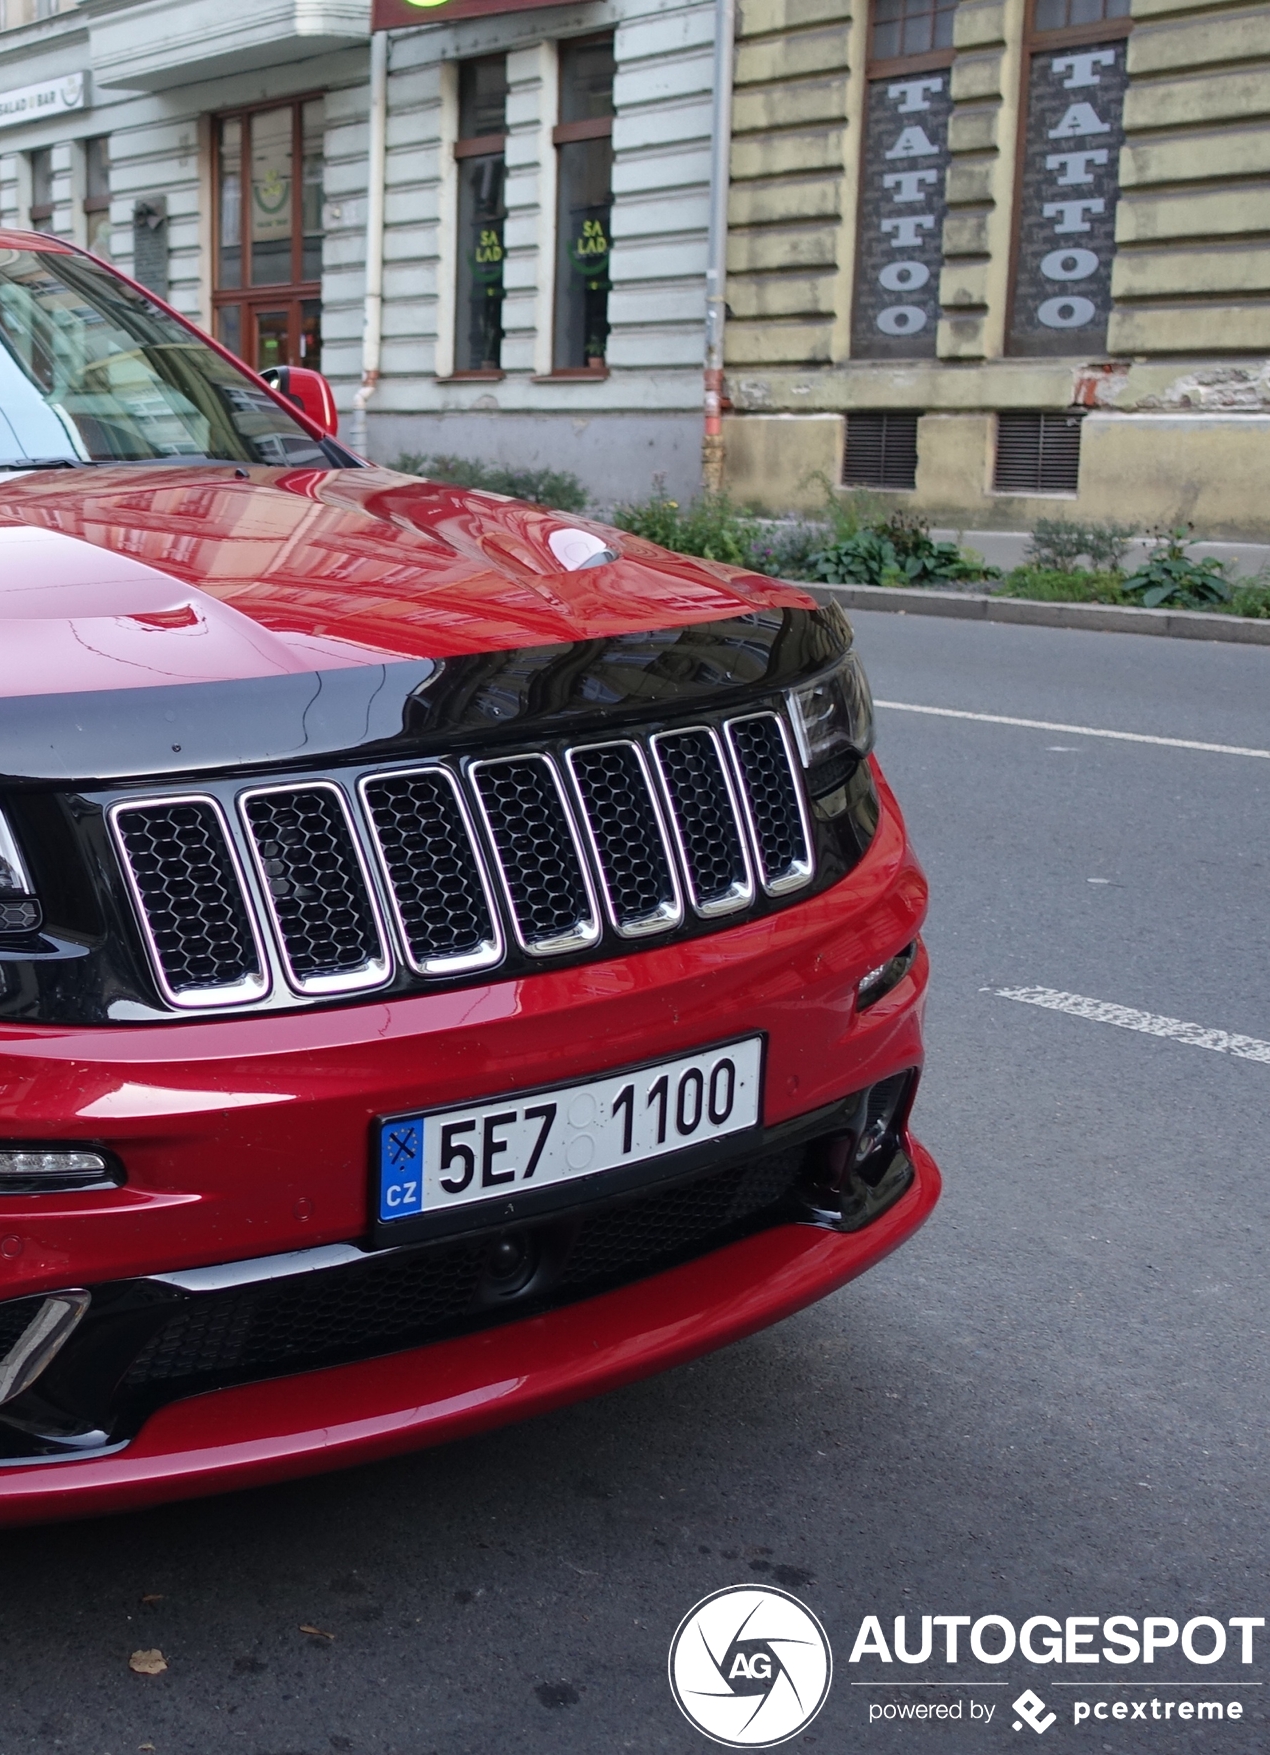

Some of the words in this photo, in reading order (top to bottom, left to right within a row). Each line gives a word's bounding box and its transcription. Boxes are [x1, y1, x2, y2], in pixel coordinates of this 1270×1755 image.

[37, 91, 55, 107] BAR
[1037, 50, 1115, 329] TATTOO
[876, 78, 943, 336] TATTOO
[582, 219, 603, 237] SA
[480, 230, 499, 247] SA
[577, 236, 608, 255] LAD
[475, 246, 503, 263] LAD
[439, 1102, 558, 1194] 5E7
[611, 1057, 736, 1154] 1100
[386, 1181, 417, 1207] CZ
